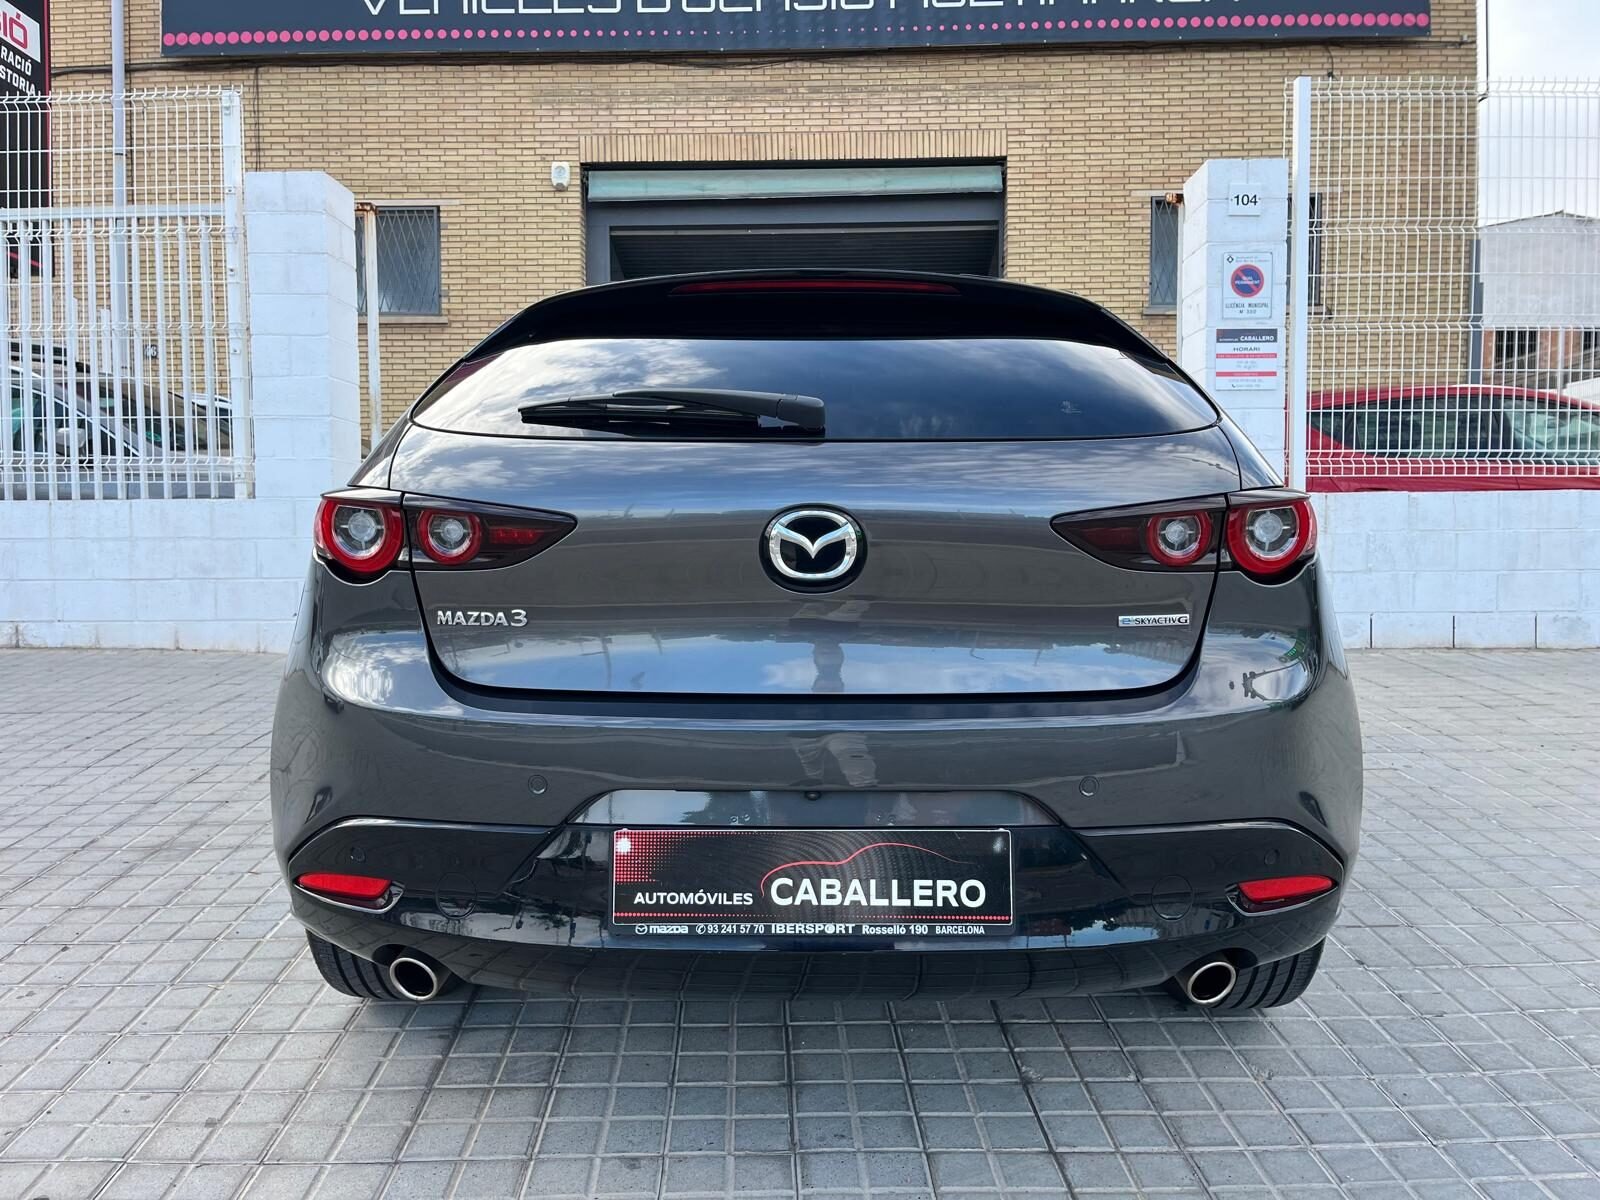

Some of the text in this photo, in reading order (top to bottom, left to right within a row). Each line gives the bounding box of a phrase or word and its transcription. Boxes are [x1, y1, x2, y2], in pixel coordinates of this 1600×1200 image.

[1233, 193, 1259, 206] 104
[633, 878, 986, 908] AUTOMÓVILES CABALLERO
[707, 924, 719, 934] 93
[721, 924, 737, 934] 241
[739, 924, 751, 934] 57
[753, 924, 765, 934] 70
[771, 924, 855, 934] IBERSPORT
[909, 924, 929, 935] 190
[935, 925, 985, 935] BARCELONA
